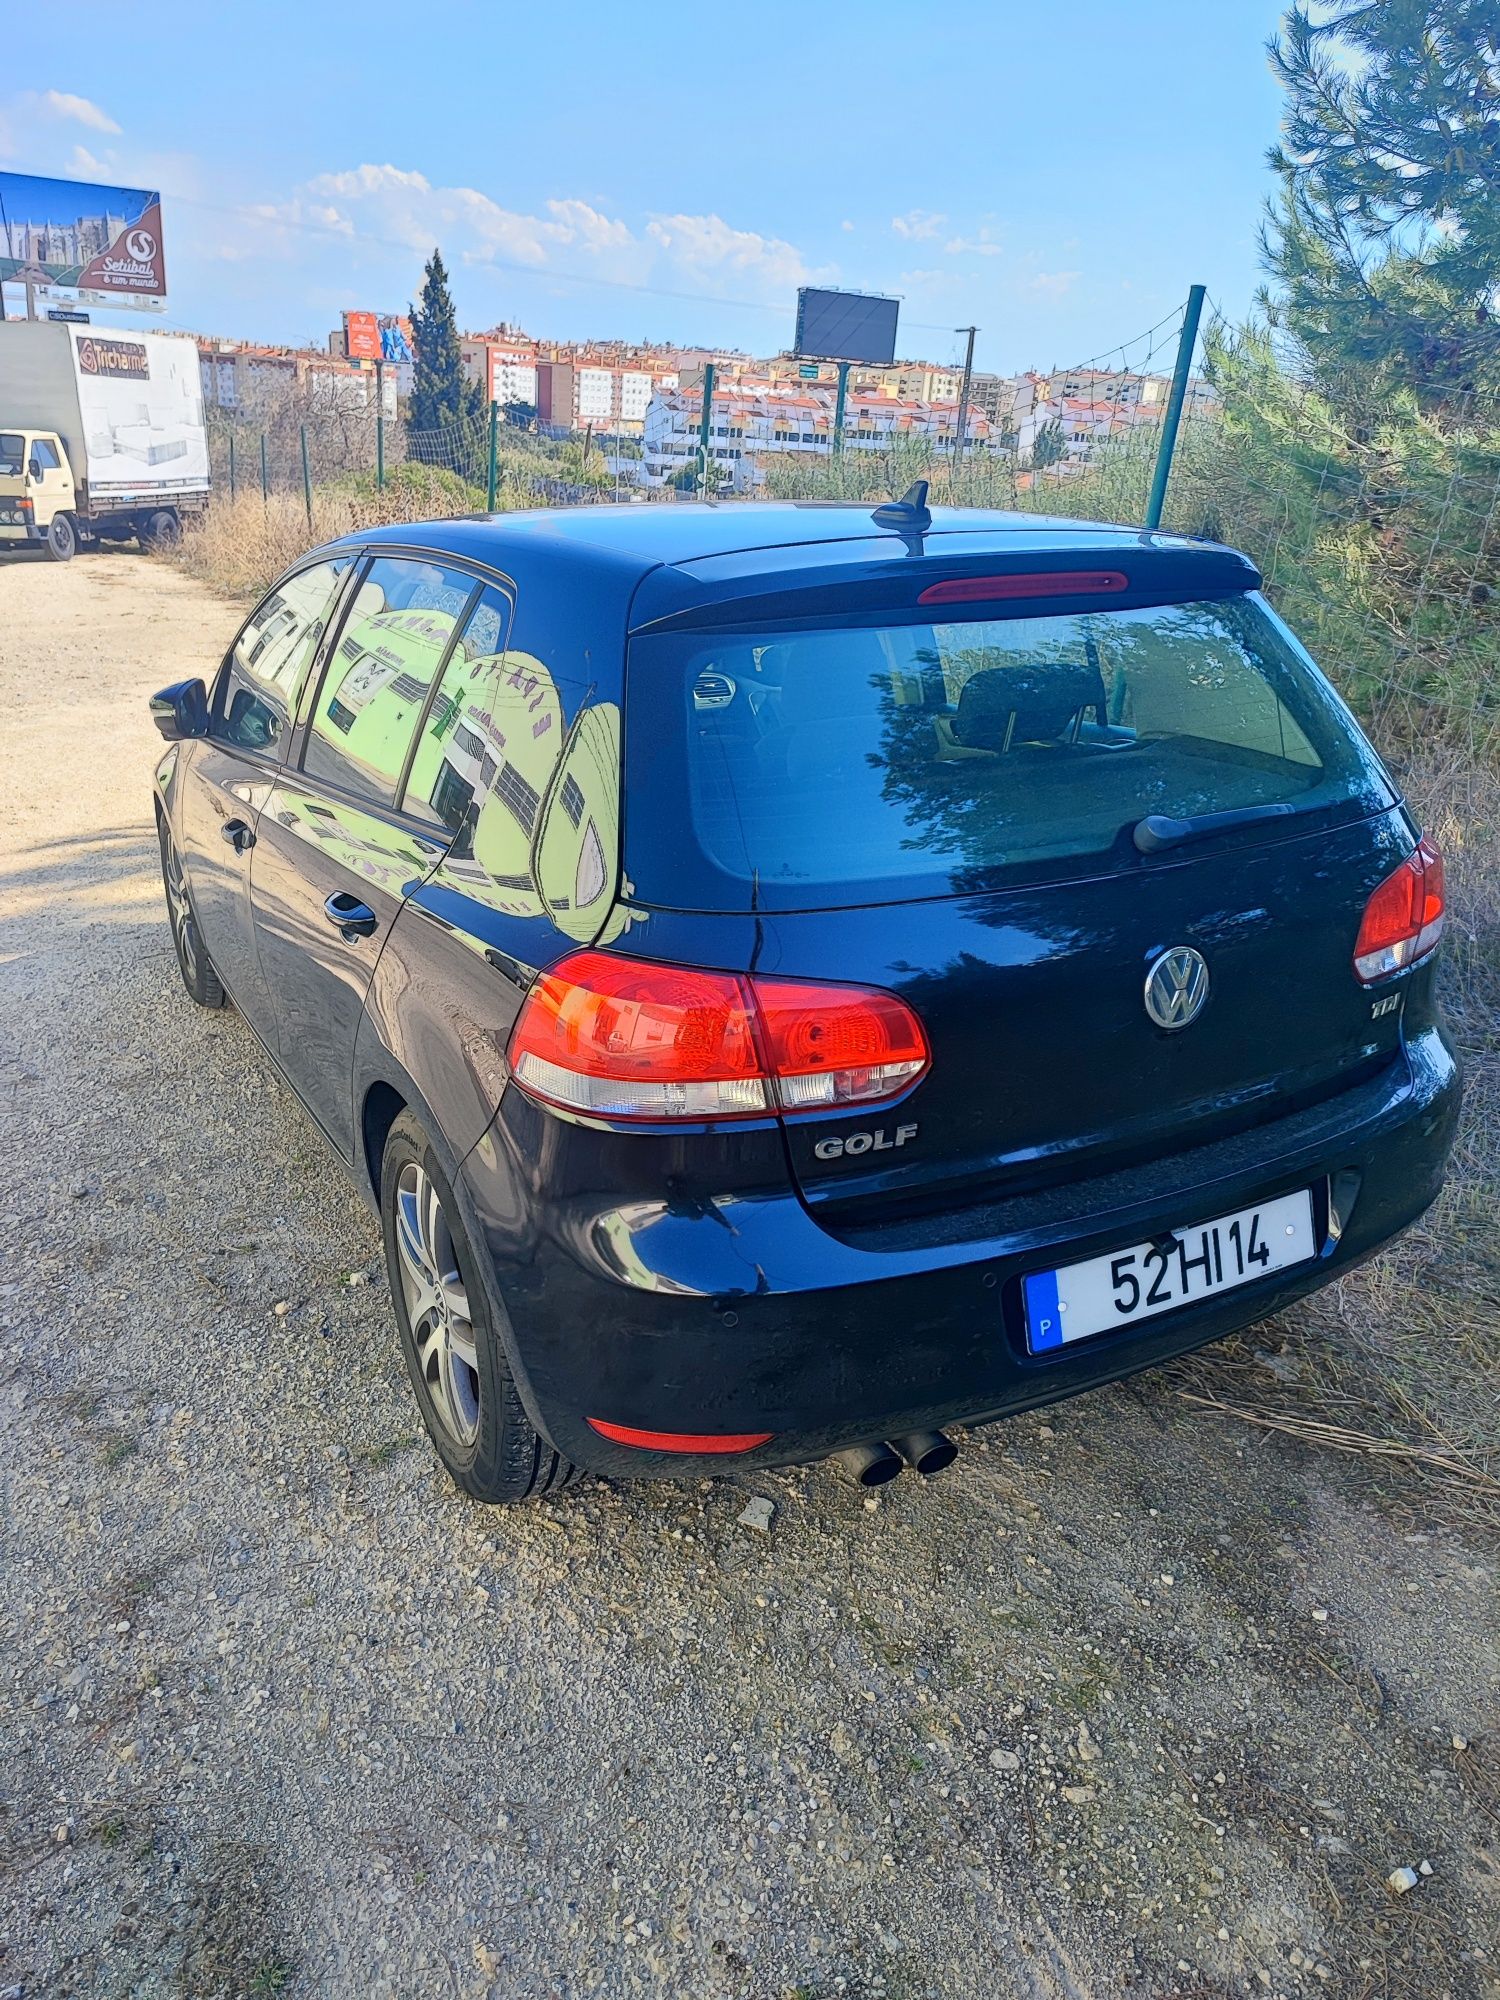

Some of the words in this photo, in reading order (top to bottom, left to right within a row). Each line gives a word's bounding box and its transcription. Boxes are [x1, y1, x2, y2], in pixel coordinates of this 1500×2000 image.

[102, 256, 154, 275] Setúbal
[112, 276, 128, 286] um
[129, 278, 159, 288] mundo
[94, 344, 149, 373] Tricharme
[1371, 992, 1401, 1019] TDI
[814, 1123, 918, 1159] GOLF
[1039, 1318, 1051, 1336] P
